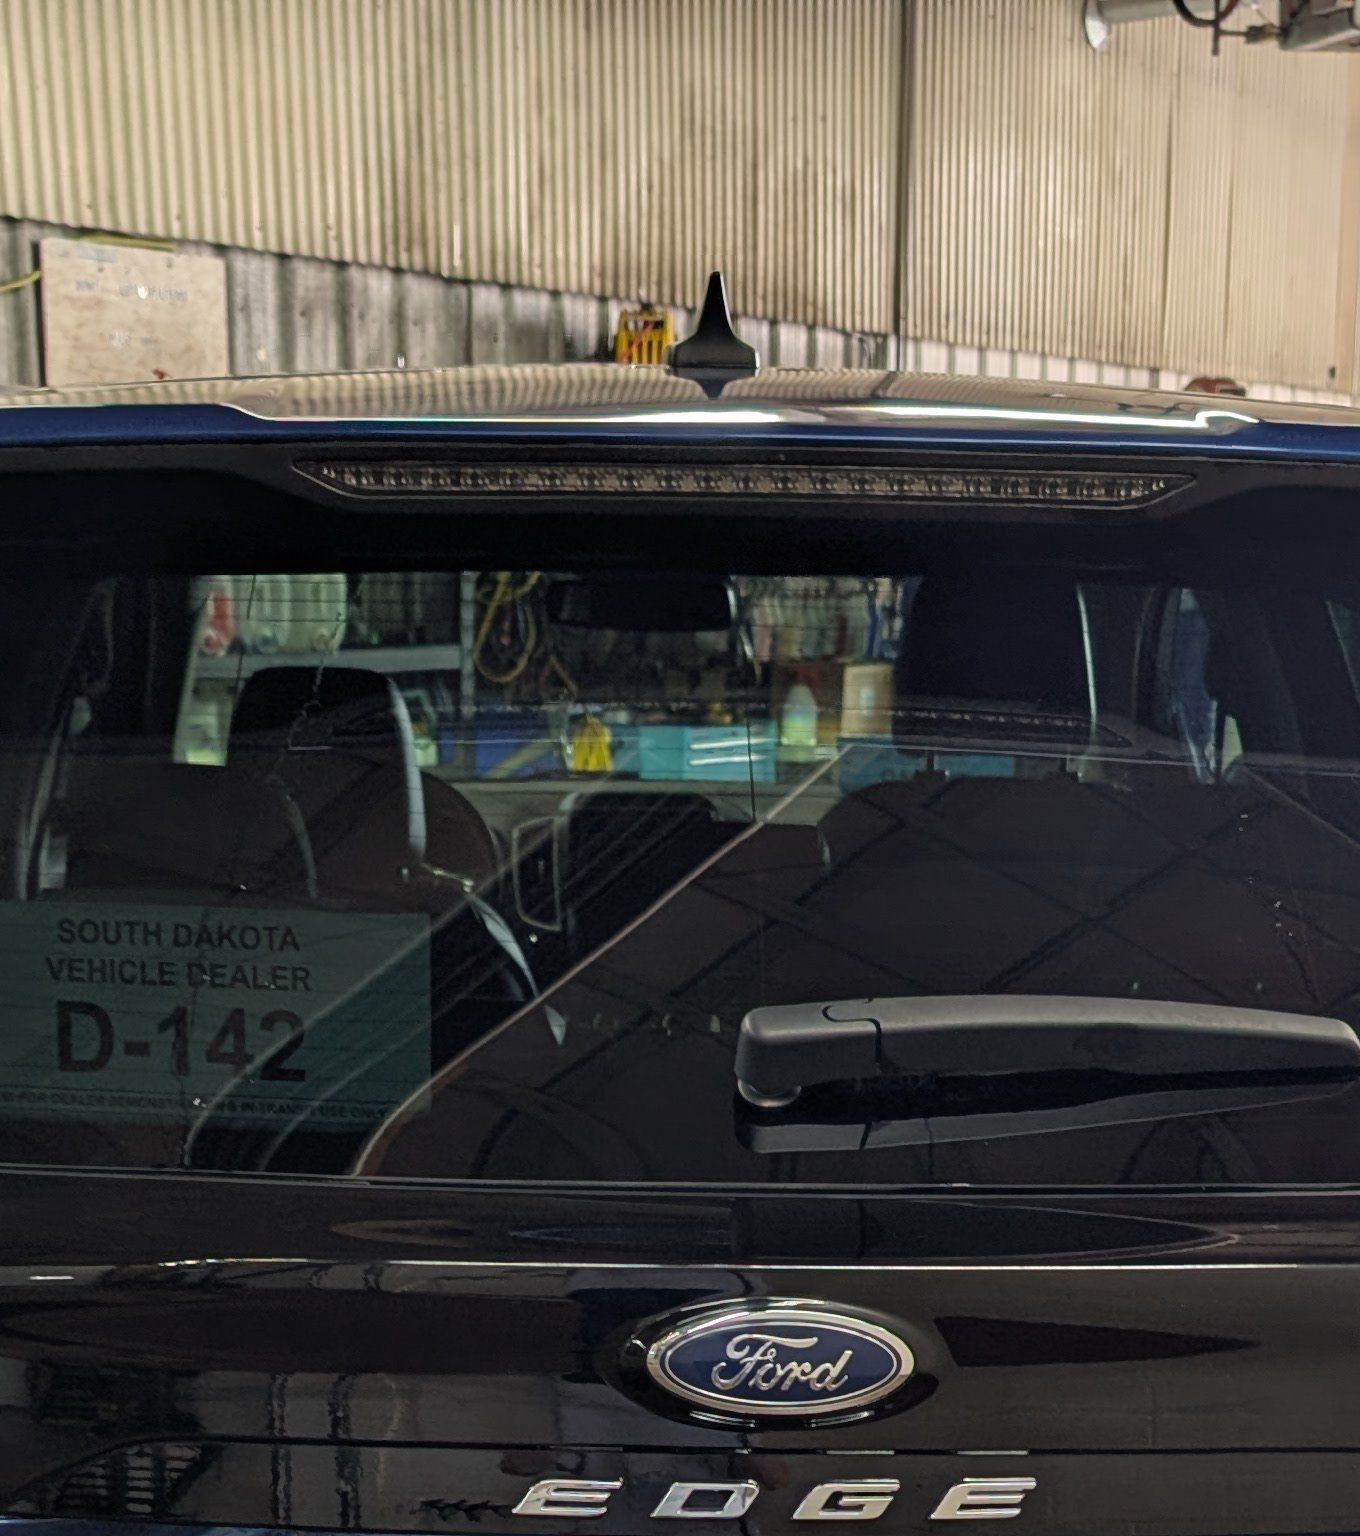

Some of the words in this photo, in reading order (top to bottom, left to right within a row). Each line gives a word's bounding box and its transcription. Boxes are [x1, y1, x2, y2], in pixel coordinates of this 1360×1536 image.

[57, 917, 161, 946] SOUTH
[173, 923, 301, 951] DAKOTA
[45, 957, 177, 986] VEHICLE
[187, 963, 313, 991] DEALER
[57, 1000, 306, 1082] D-142
[710, 1332, 853, 1397] Ford
[511, 1476, 1037, 1521] EDGE
